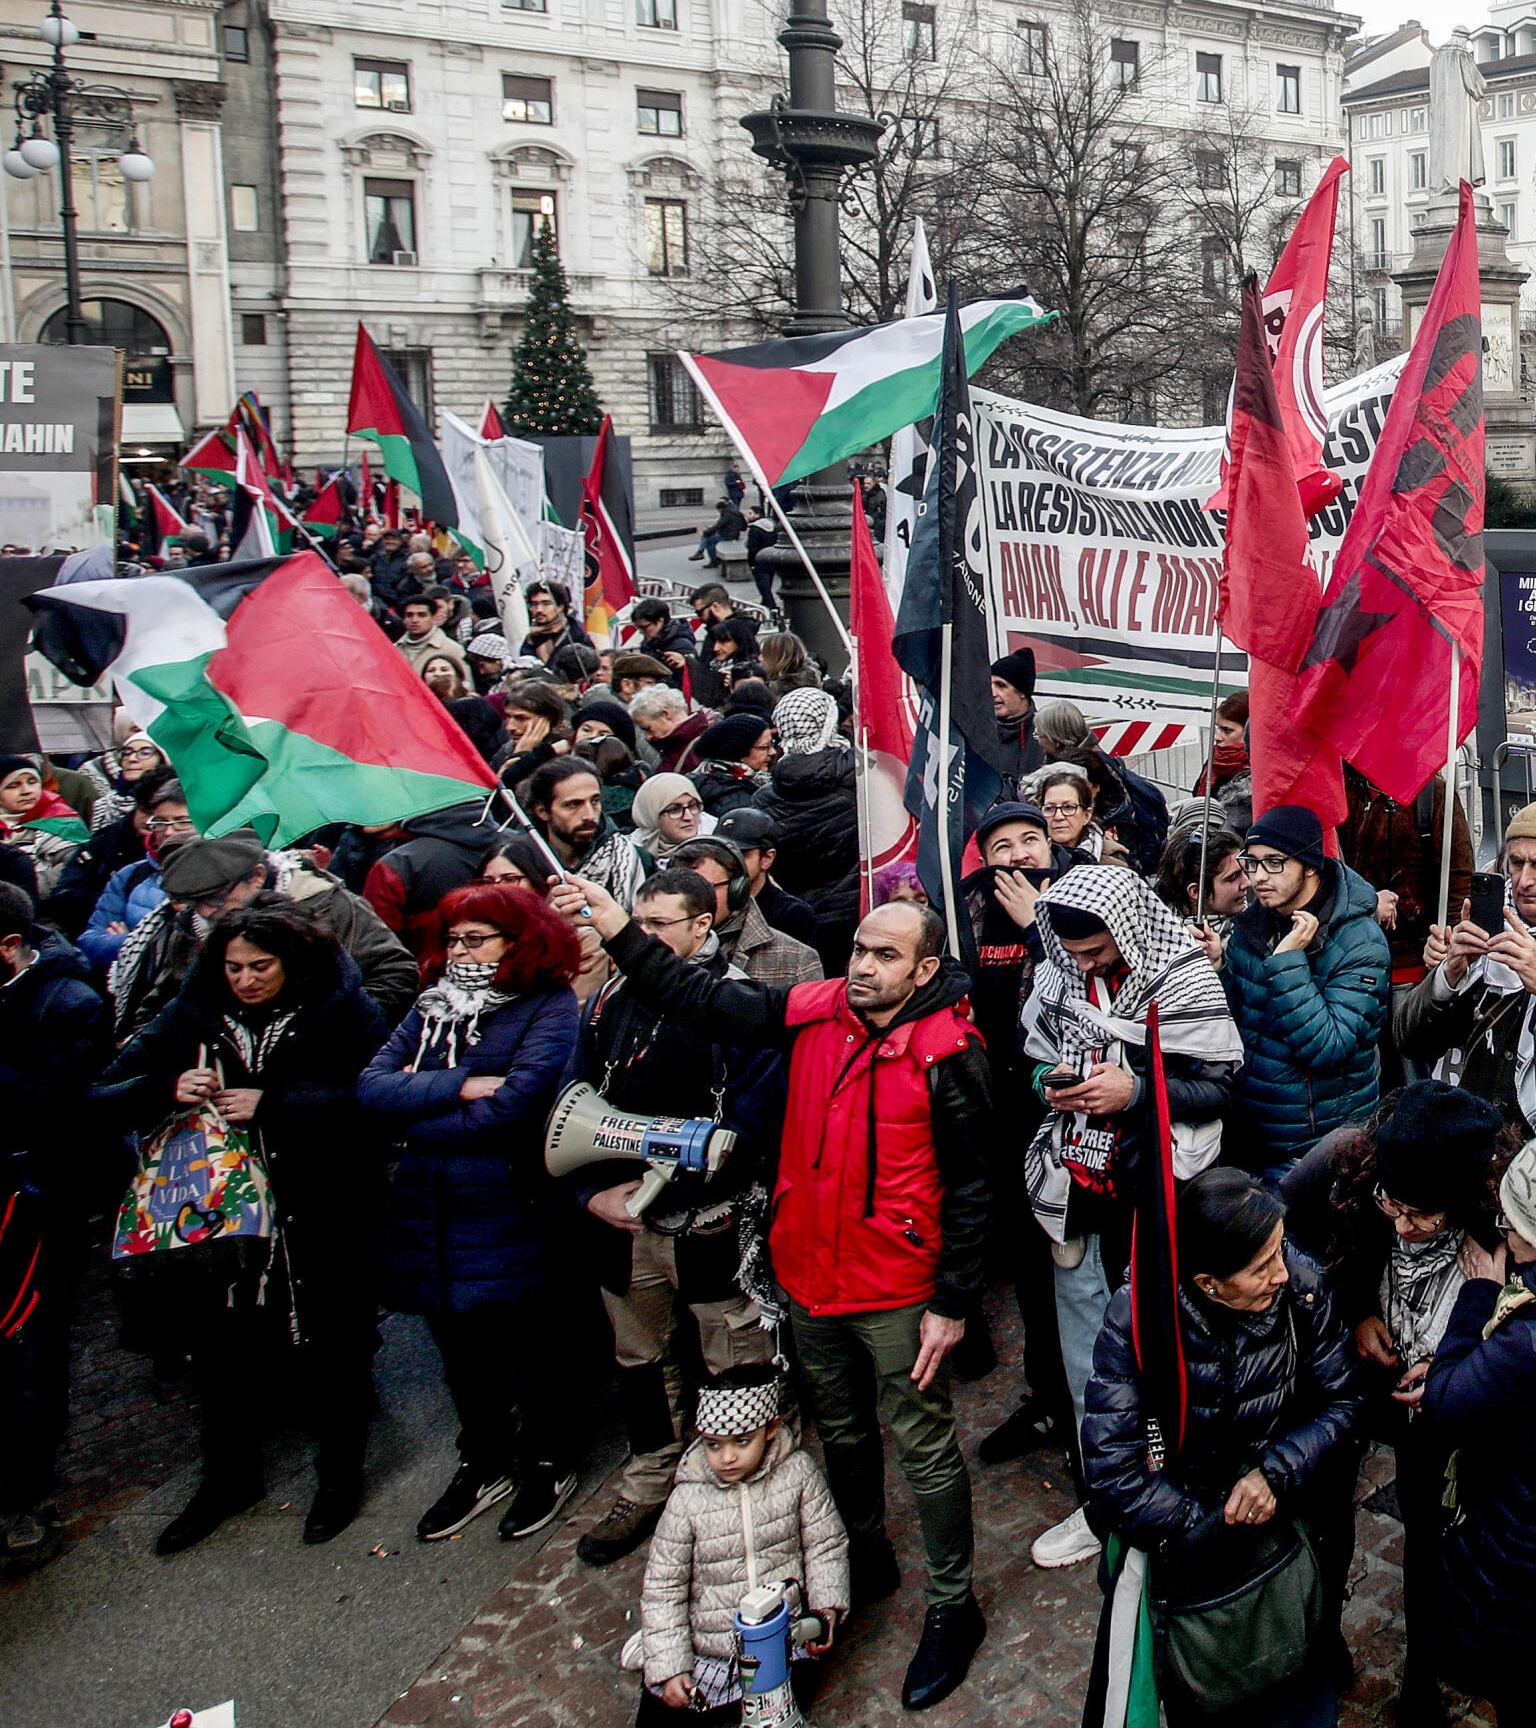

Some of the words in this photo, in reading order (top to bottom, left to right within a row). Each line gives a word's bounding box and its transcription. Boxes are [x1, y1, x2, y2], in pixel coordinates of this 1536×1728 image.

[990, 481, 1018, 531] LA
[1151, 499, 1218, 547] NON
[1078, 548, 1128, 630] ALI
[1127, 550, 1150, 631] E
[1518, 600, 1523, 612] I
[601, 1115, 632, 1131] FREE
[592, 1132, 641, 1153] PALESTINE
[1084, 1128, 1115, 1151] FREE
[160, 1184, 201, 1204] VIDA
